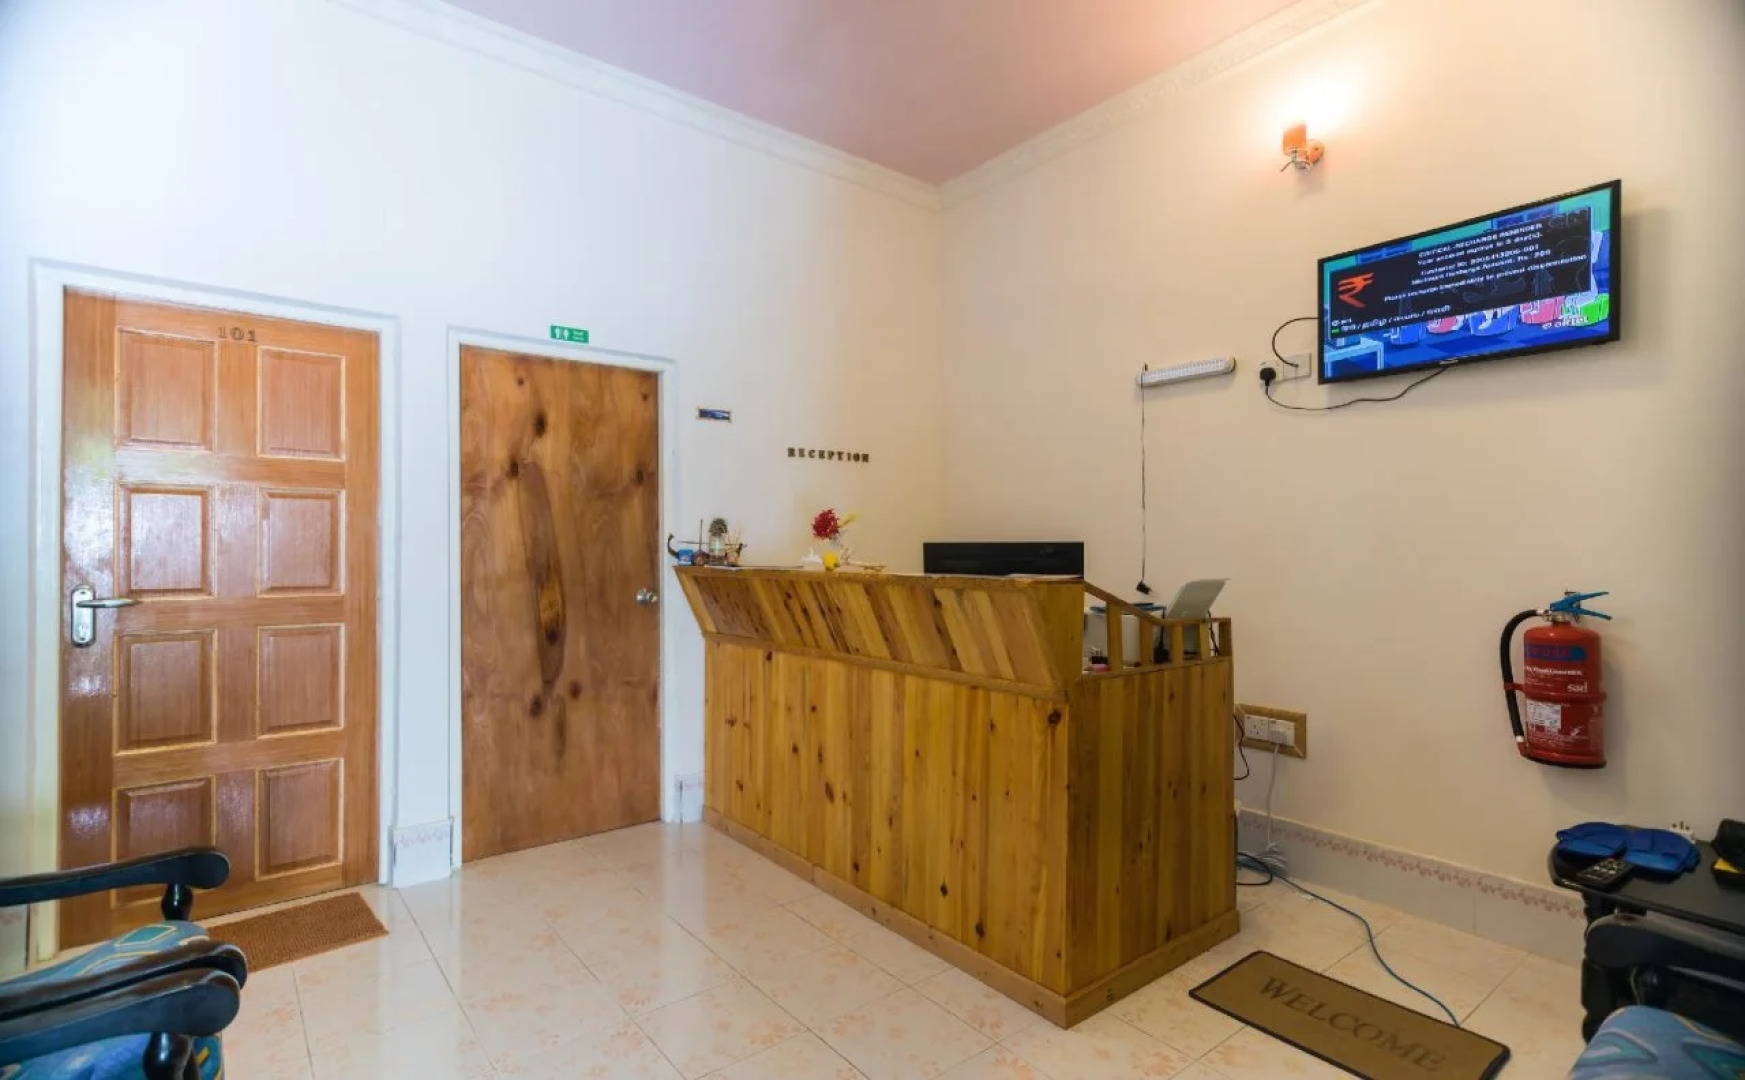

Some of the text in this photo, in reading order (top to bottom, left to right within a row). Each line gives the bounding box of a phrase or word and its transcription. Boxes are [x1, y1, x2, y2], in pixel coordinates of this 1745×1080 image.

[217, 326, 257, 342] 101
[787, 447, 870, 463] RECEPTION
[1259, 976, 1447, 1072] WELCOME
